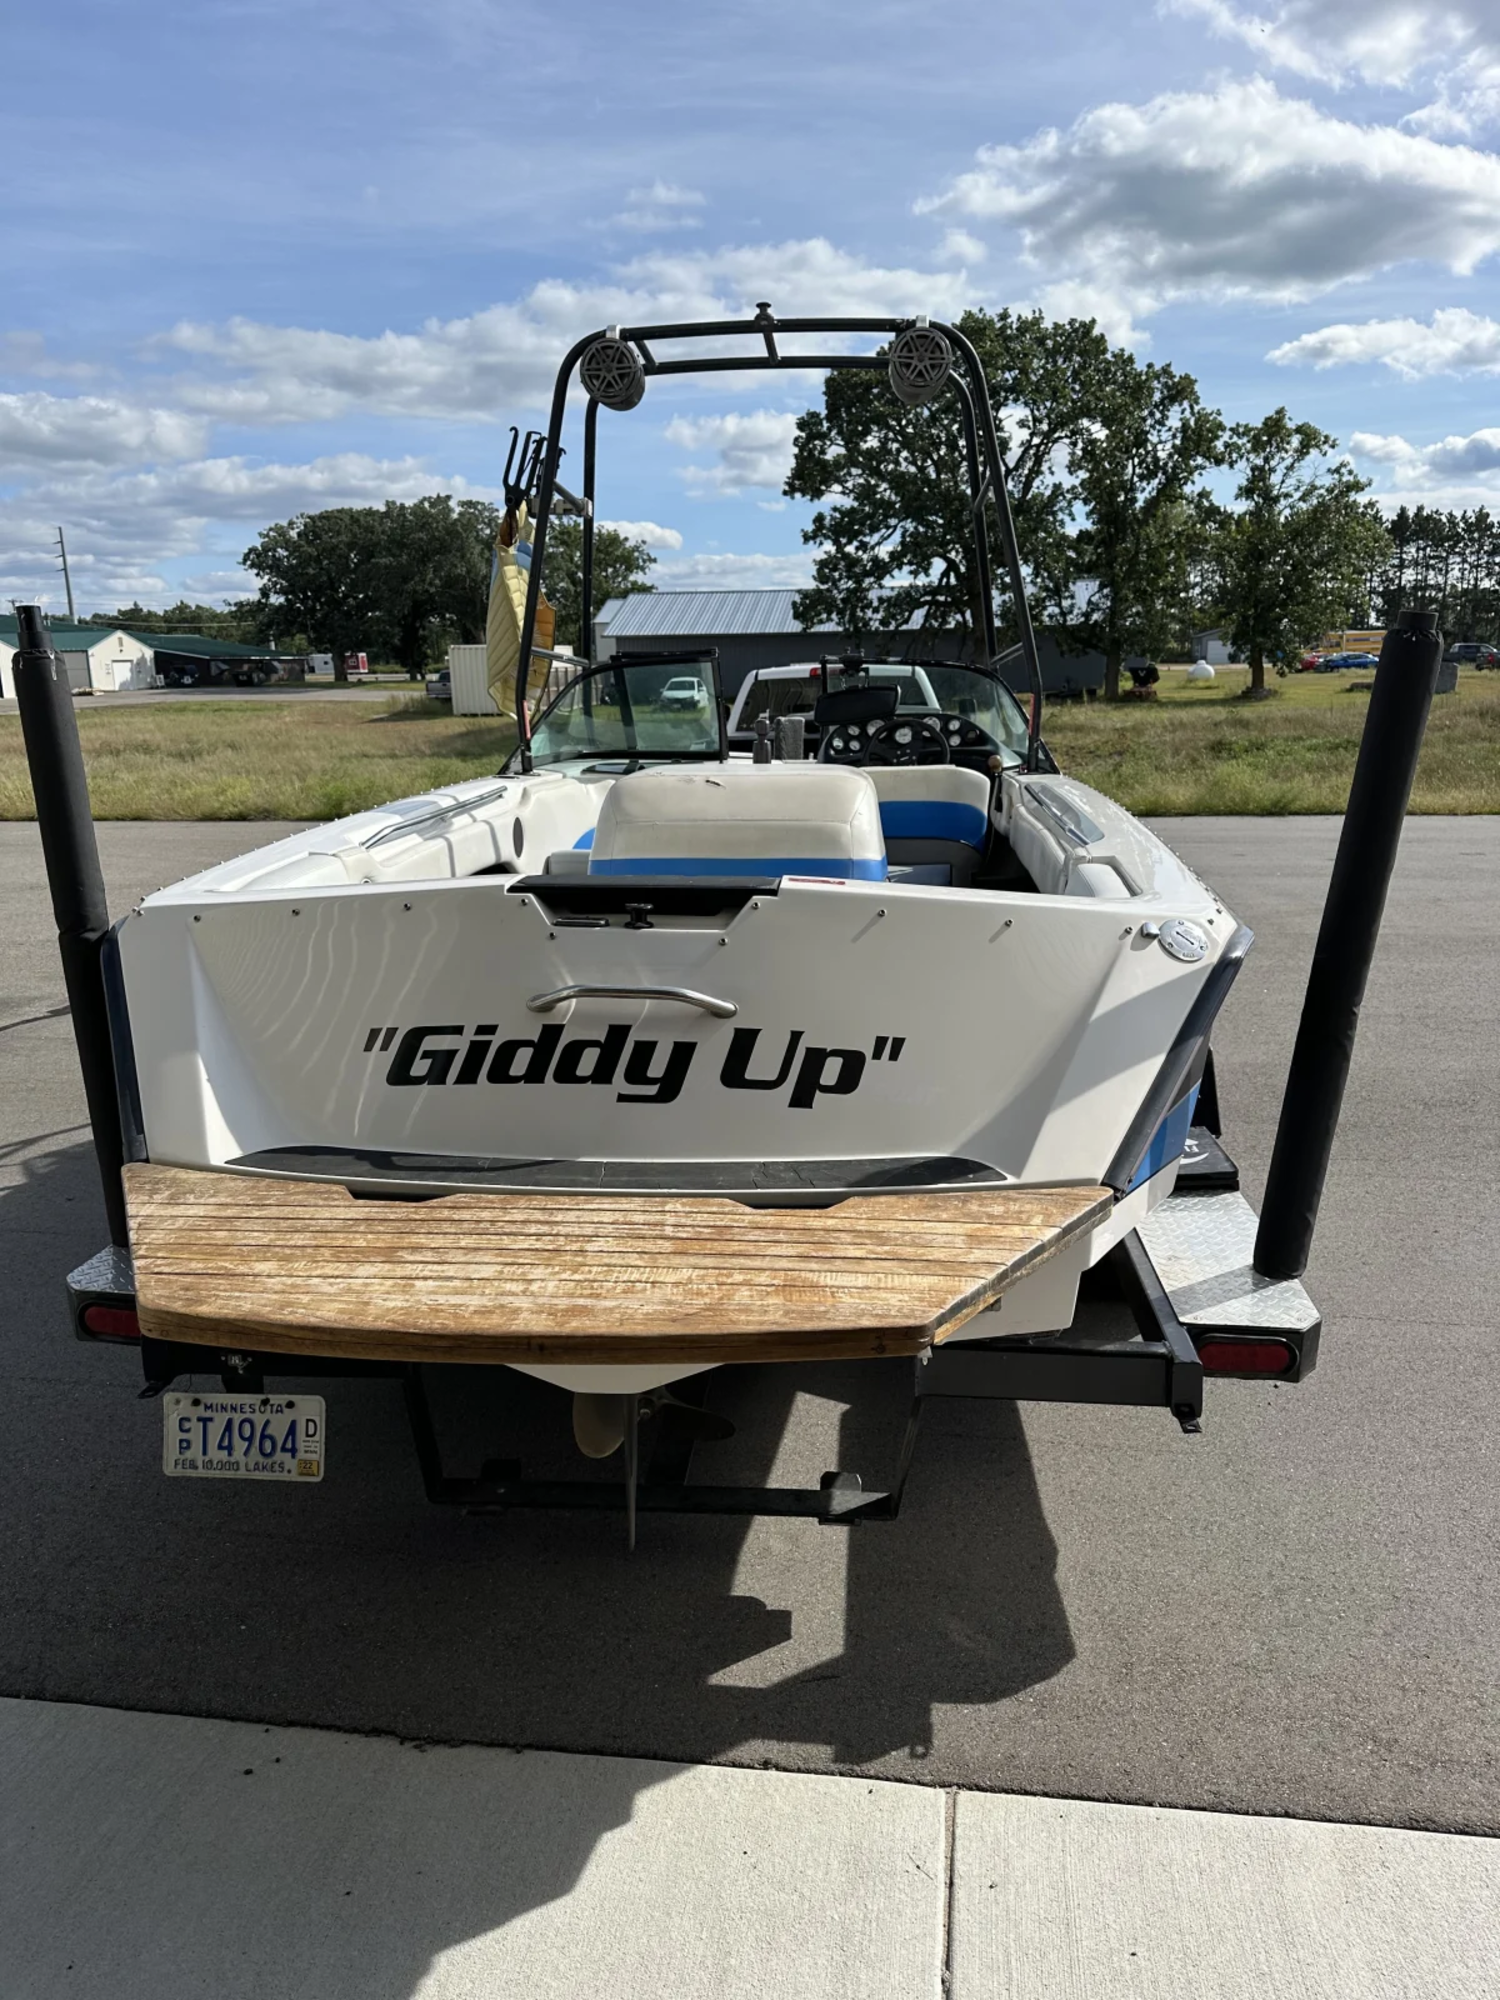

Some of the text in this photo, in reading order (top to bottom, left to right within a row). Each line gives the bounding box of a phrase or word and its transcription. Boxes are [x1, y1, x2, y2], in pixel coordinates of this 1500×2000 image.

[363, 1023, 906, 1109] "Giddy Up"
[203, 1401, 285, 1414] MINNESOTA
[196, 1416, 298, 1459] T4964
[305, 1418, 318, 1438] D
